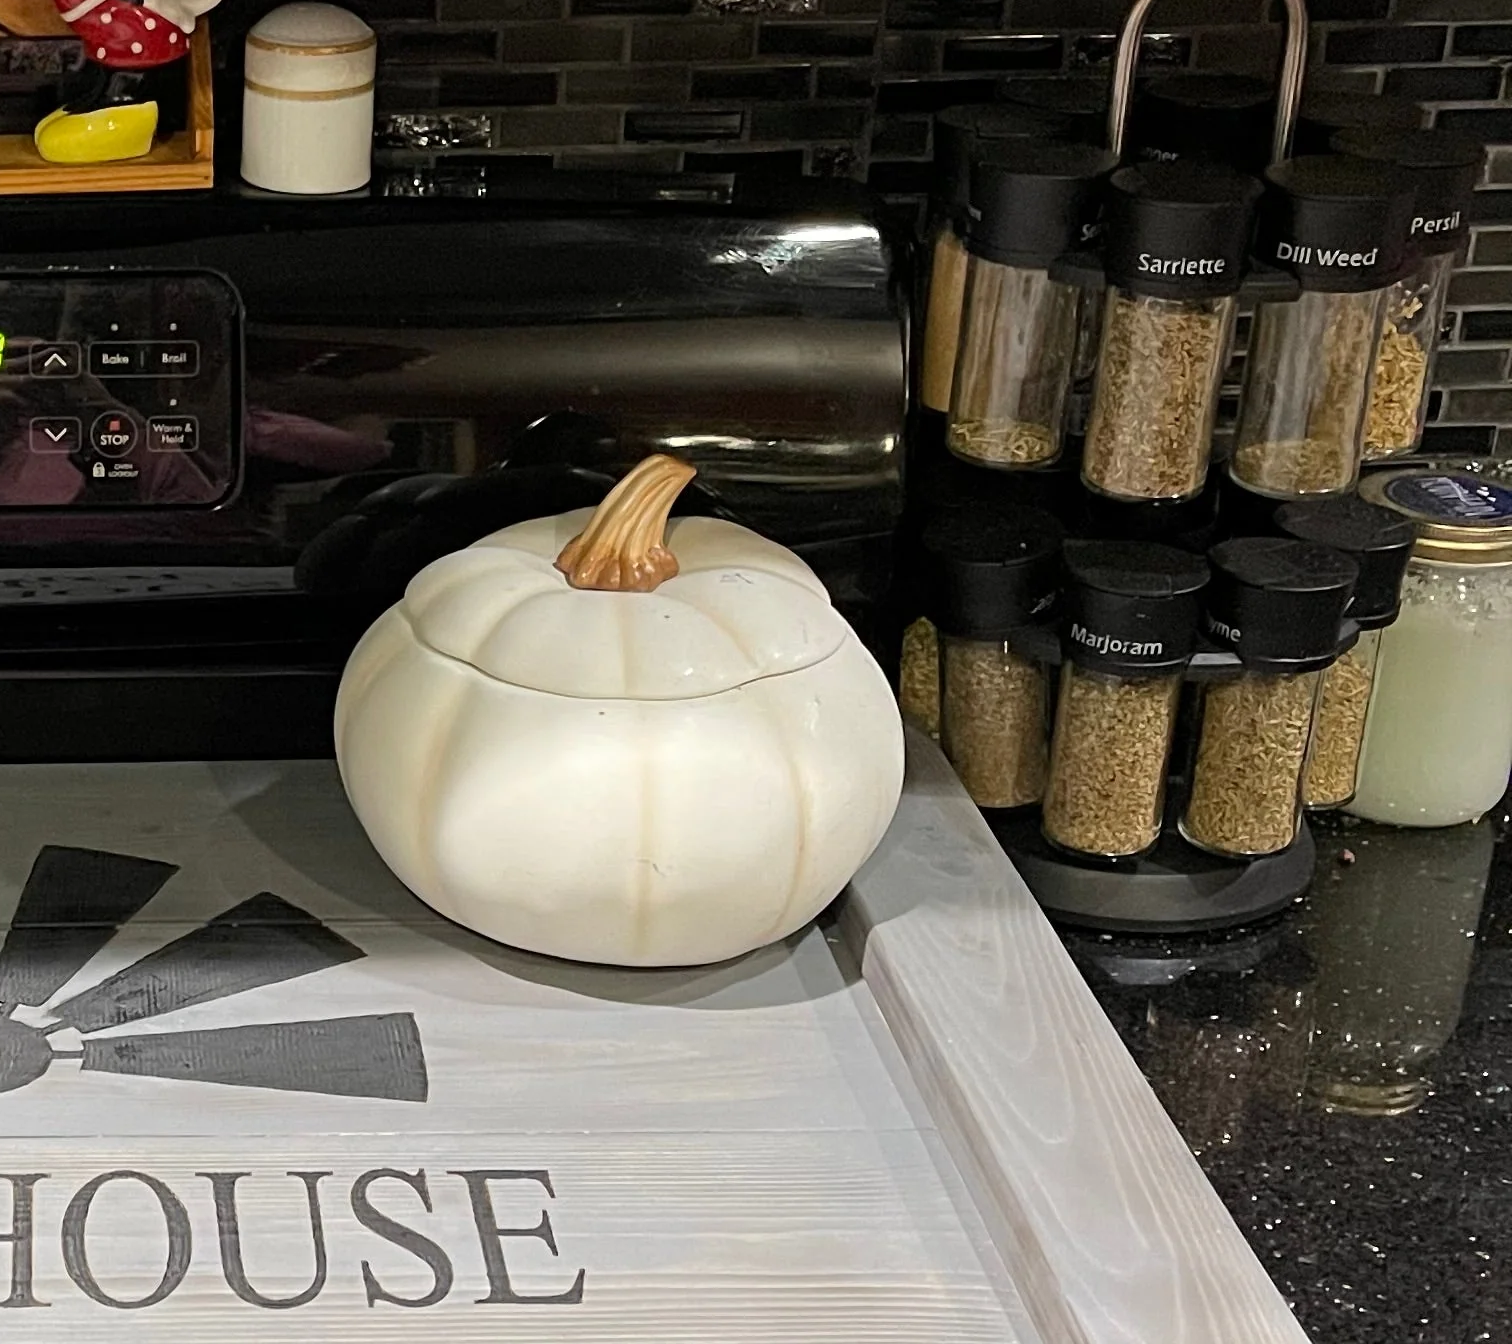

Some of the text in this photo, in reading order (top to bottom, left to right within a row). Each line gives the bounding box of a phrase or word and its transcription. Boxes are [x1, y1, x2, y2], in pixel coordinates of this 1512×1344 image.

[1410, 211, 1461, 235] Persil
[1276, 242, 1379, 267] Dill Weed
[1137, 253, 1226, 275] Sarriette
[102, 353, 129, 364] Bake
[162, 352, 187, 363] Broil
[152, 423, 193, 433] Warm &
[100, 434, 130, 445] STOP
[161, 434, 185, 444] Hold
[1070, 623, 1163, 656] Marjoram
